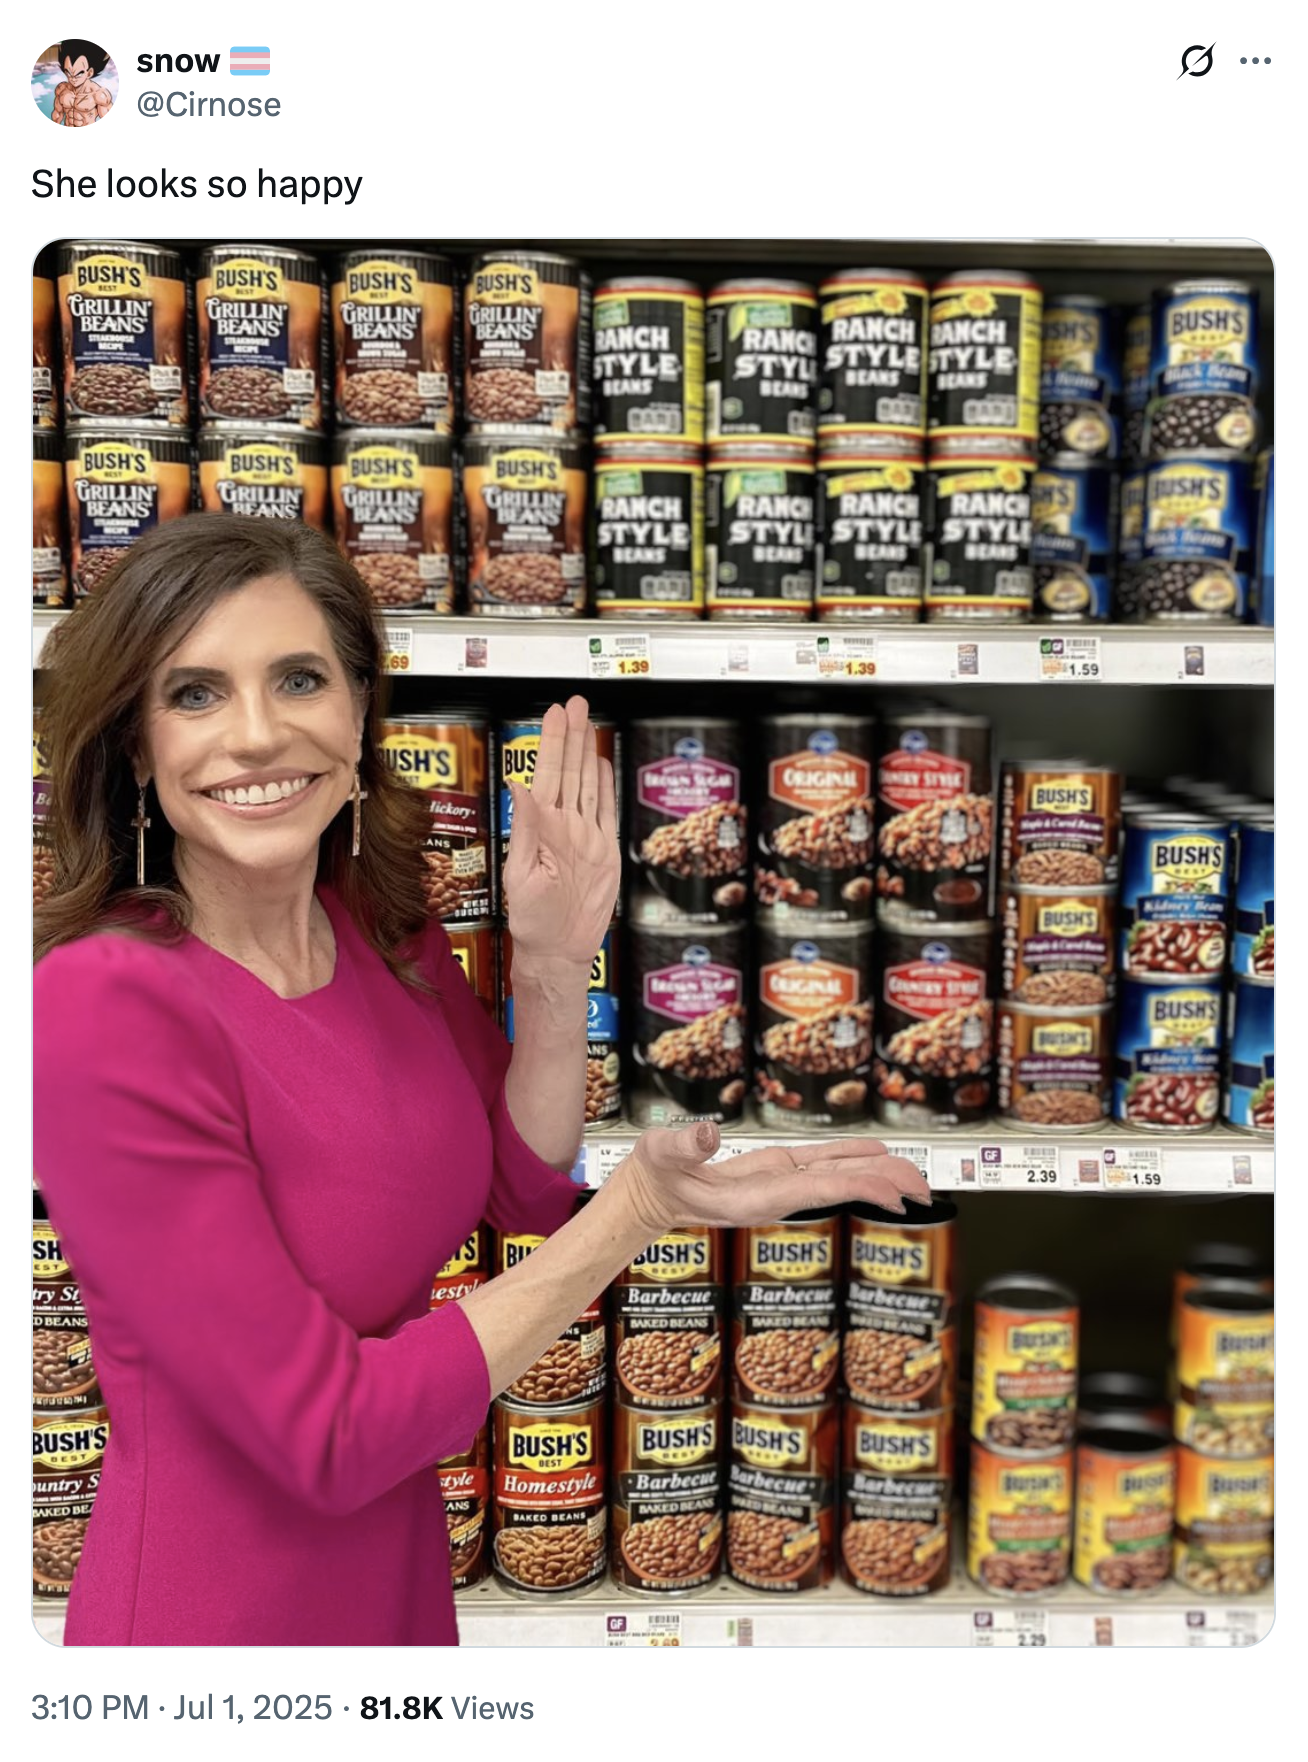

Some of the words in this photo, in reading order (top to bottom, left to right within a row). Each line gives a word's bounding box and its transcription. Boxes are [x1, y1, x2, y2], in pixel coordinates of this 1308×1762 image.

[78, 265, 141, 287] BUSH'S
[216, 269, 278, 292] BUSH'S
[350, 272, 412, 294] BUSH'S
[476, 273, 532, 295] BUSH'S
[68, 294, 152, 317] GRILLIN'
[206, 298, 288, 320] GRILLIN'
[341, 302, 421, 324] GRILLIN'
[469, 303, 542, 325] GRILLIN'
[81, 316, 145, 333] BEANS
[217, 319, 280, 336] BEANS
[352, 322, 414, 340] BEANS
[476, 323, 533, 340] BEANS
[831, 317, 916, 343] RANCH
[1173, 311, 1244, 335] BUSH'S
[825, 344, 920, 374] STYLE
[846, 369, 899, 386] BEANS
[84, 452, 146, 473] BUSH'S
[230, 454, 294, 475] BUSH'S
[351, 458, 413, 478] BUSH'S
[496, 460, 558, 480] BUSH'S
[74, 480, 157, 502] GRILLIN'
[217, 481, 303, 503] GRILLIN'
[86, 501, 150, 518] BEANS
[600, 496, 682, 521] RANCH
[598, 522, 690, 550] STYLE
[613, 547, 666, 564] BEANS
[618, 660, 649, 674] 1.39
[845, 662, 876, 675] 1.39
[1069, 664, 1099, 676] 1.59
[783, 769, 858, 788] ORIGINAL
[1036, 787, 1089, 805] BUSH'S
[1156, 844, 1222, 868] BUSH'S
[1043, 909, 1095, 927] BUSH'S
[1155, 1000, 1217, 1021] BUSH'S
[984, 1151, 998, 1161] GF
[1028, 1170, 1057, 1182] 2.39
[1133, 1173, 1161, 1185] 1.59
[757, 1239, 828, 1265] BUSH'S
[855, 1239, 923, 1270] BUSH'S
[628, 1288, 712, 1304] Barbecue
[750, 1286, 833, 1303] Barbecue
[45, 1317, 88, 1327] BEANS
[670, 1318, 708, 1328] BEANS
[33, 1426, 106, 1455] BUSH'S
[513, 1432, 588, 1458] BUSH'S
[643, 1423, 713, 1451] BUSH'S
[734, 1421, 801, 1455] BUSH'S
[860, 1431, 930, 1456] BUSH'S
[51, 1453, 87, 1463] BEST
[538, 1459, 562, 1468] BEST
[504, 1472, 596, 1496] Homestyle
[636, 1470, 717, 1491] Barbecue
[33, 1507, 70, 1518] BAKED
[513, 1512, 547, 1522] BAKED
[551, 1512, 586, 1522] BEANS
[610, 1619, 623, 1629] GF
